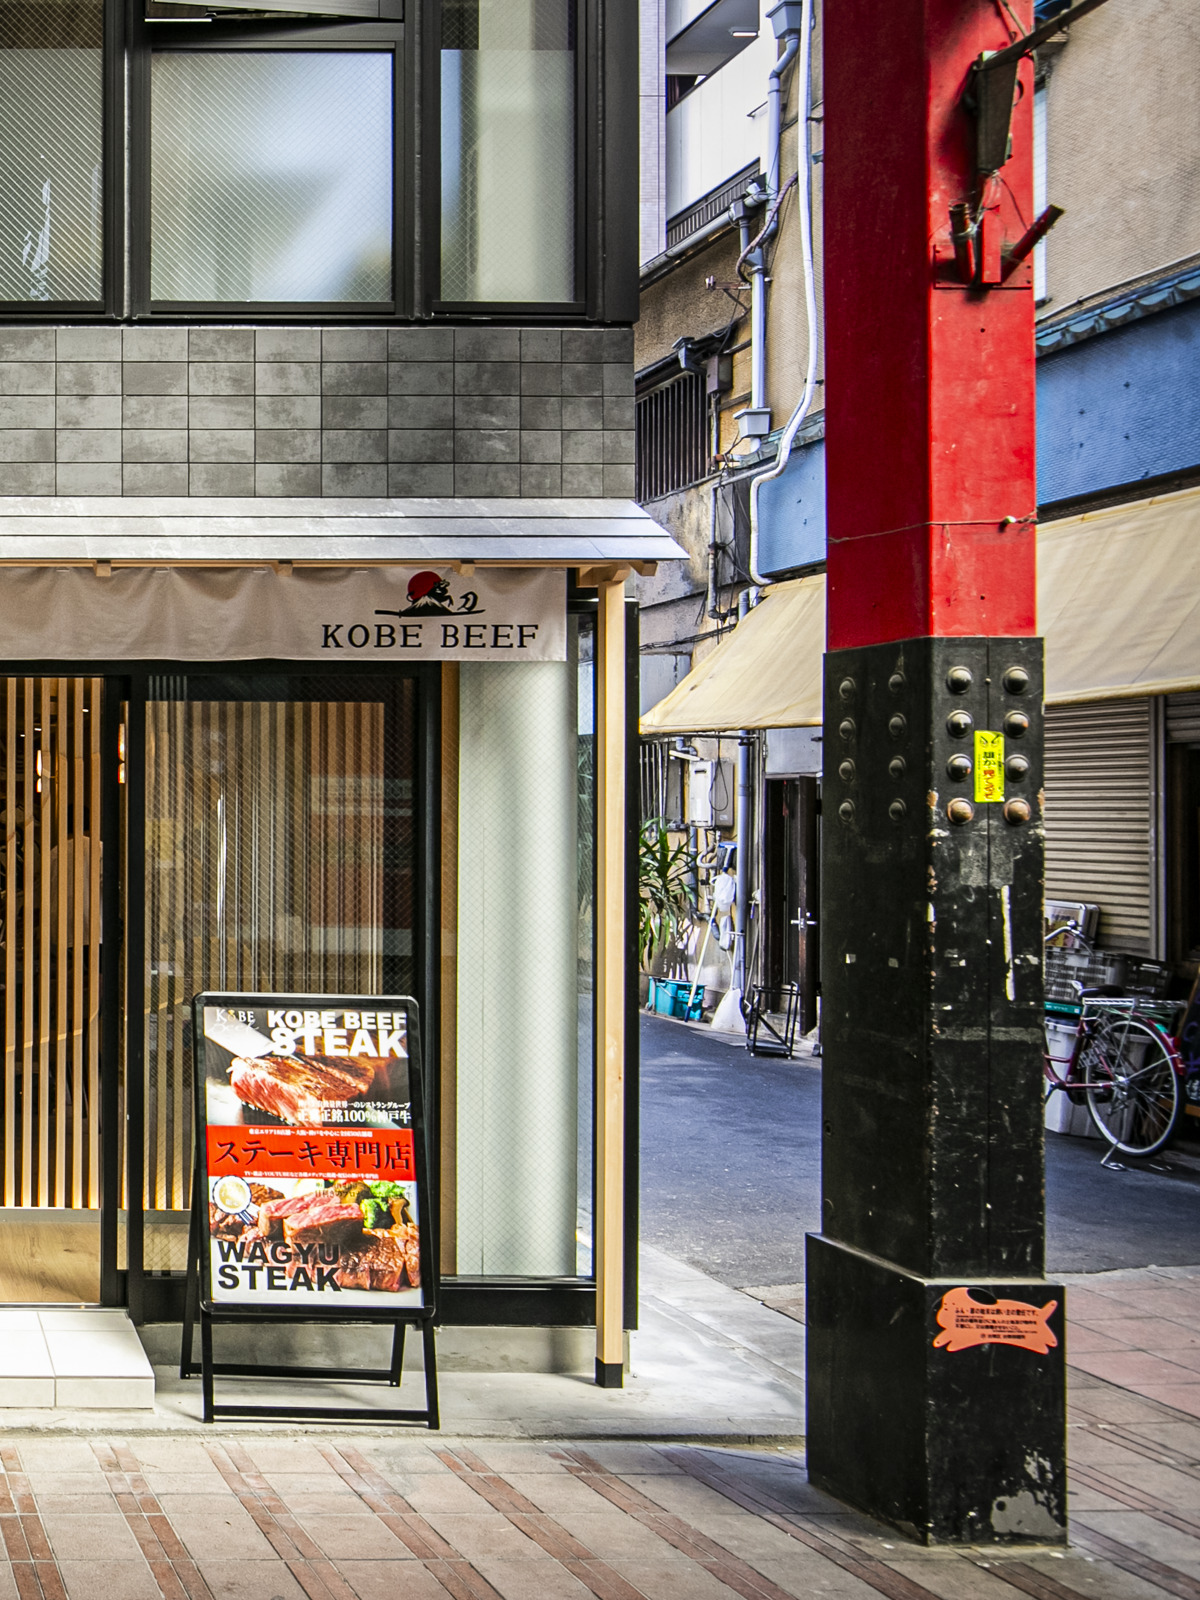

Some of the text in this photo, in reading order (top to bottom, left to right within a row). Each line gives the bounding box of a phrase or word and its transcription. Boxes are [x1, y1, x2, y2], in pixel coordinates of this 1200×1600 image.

[321, 624, 539, 648] KOBE BEEF
[267, 1010, 407, 1030] KOBE BEEF
[270, 1028, 409, 1058] STEAK
[214, 1140, 412, 1171] ステーキ専門店
[217, 1241, 341, 1265] WAGYU
[217, 1265, 343, 1292] STEAK
